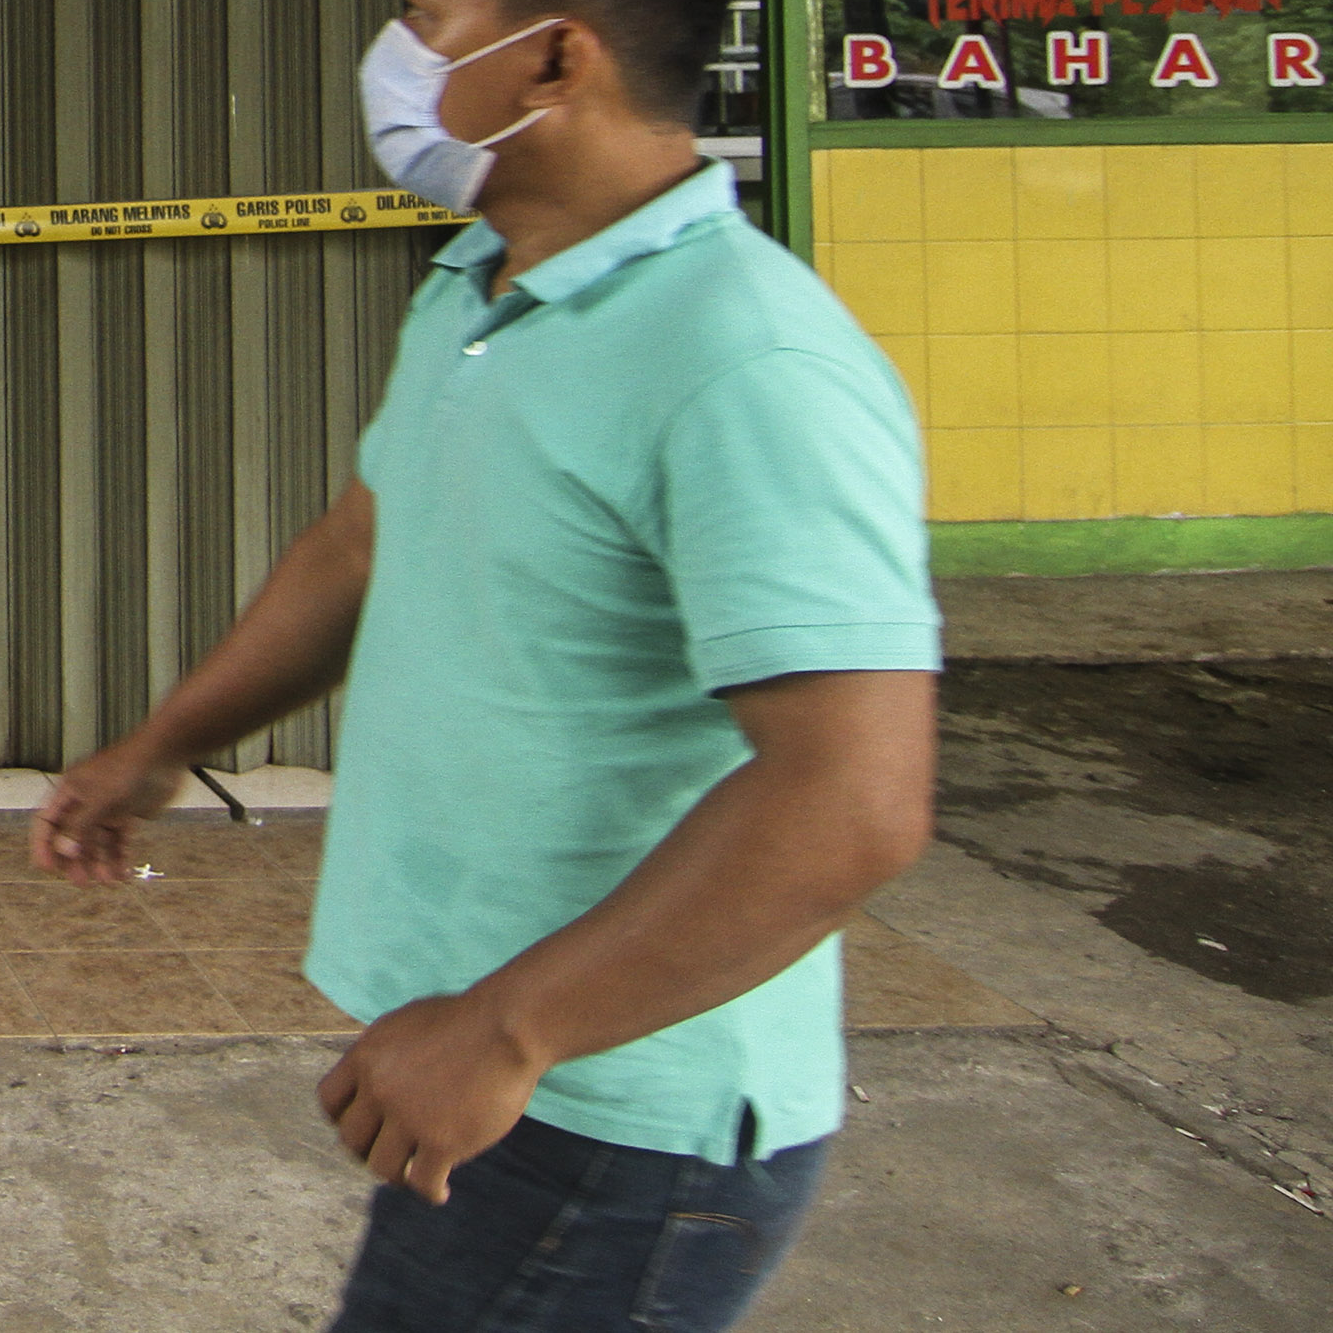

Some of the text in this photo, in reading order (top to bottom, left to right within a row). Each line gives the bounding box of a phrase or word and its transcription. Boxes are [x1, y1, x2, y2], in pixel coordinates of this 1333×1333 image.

[843, 30, 1324, 89] BAHAR
[50, 204, 191, 225] DILARANG MELINTAS
[236, 197, 332, 217] GARIS POLISI
[258, 217, 311, 229] POLICE LINE
